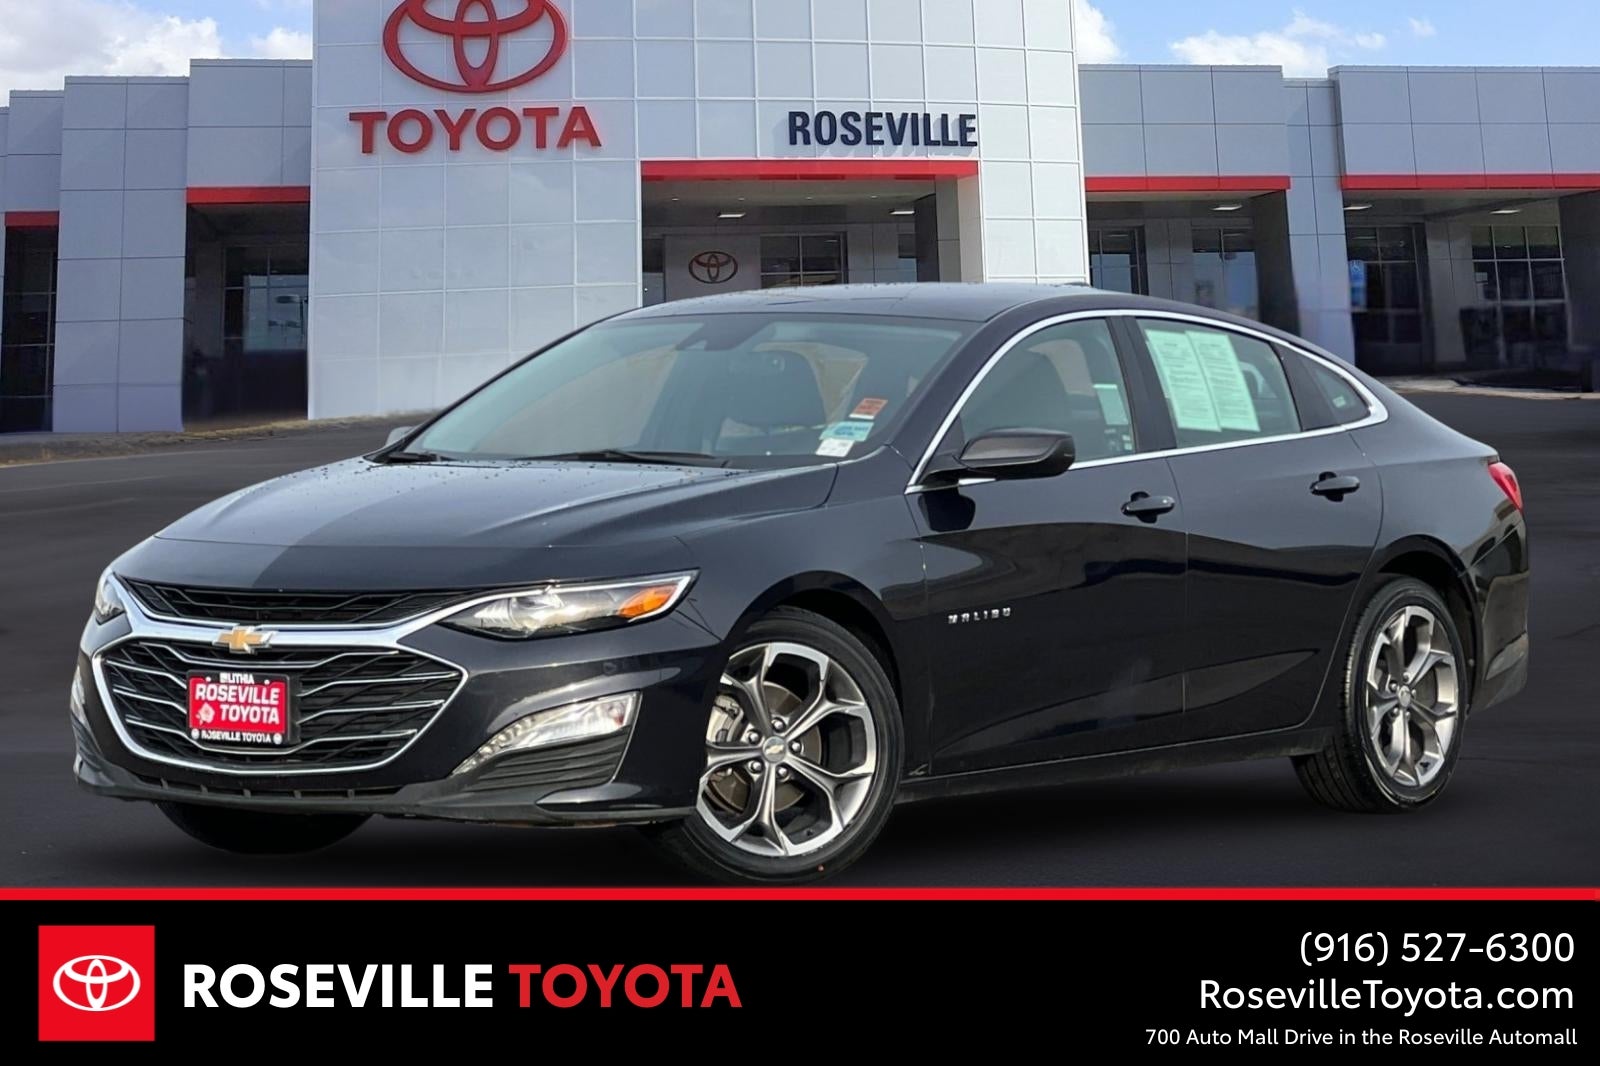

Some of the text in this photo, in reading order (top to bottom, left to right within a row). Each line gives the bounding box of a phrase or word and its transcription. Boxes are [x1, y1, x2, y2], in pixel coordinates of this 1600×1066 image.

[349, 106, 602, 154] TOYOTA
[787, 110, 978, 147] ROSEVILLE
[947, 606, 1011, 625] MALIBU
[227, 672, 255, 684] LITHIA
[194, 683, 280, 705] ROSEVILLE
[219, 704, 280, 725] TOYOTA
[201, 730, 272, 743] ROSEVILLE TOYOTA
